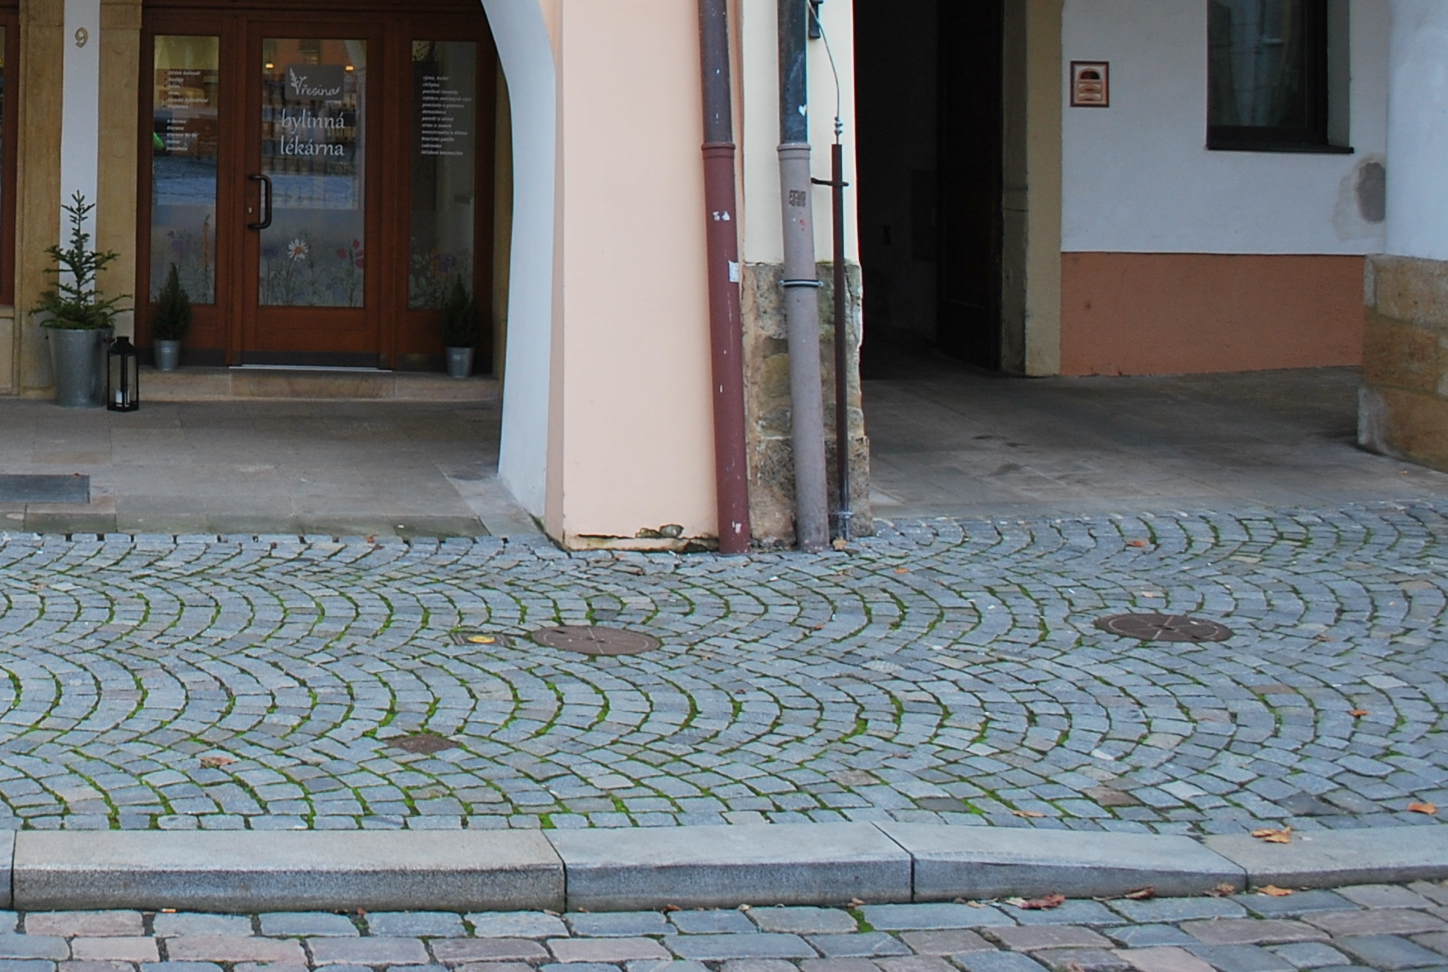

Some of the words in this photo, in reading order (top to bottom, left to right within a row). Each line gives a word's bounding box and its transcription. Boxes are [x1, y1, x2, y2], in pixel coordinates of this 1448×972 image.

[74, 26, 89, 49] 9
[281, 108, 344, 135] bylinná
[280, 135, 345, 156] lékárna
